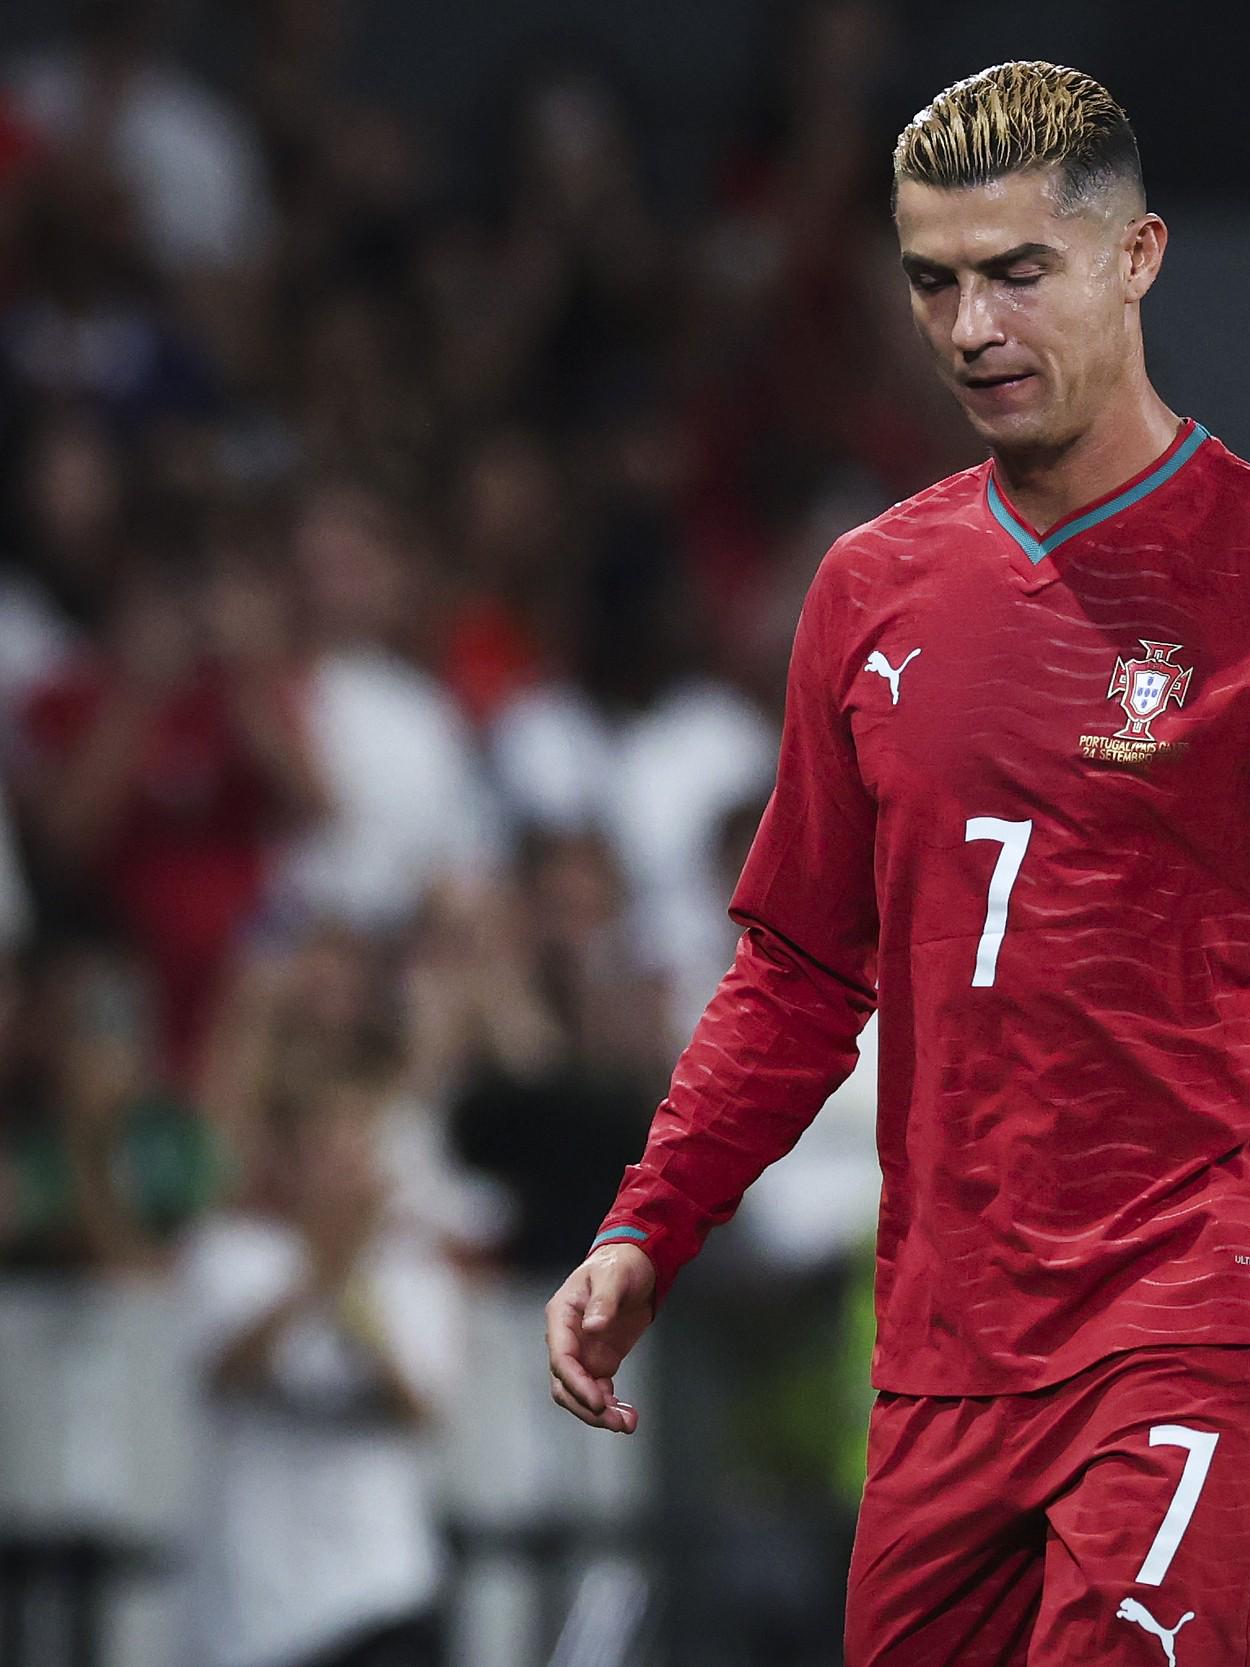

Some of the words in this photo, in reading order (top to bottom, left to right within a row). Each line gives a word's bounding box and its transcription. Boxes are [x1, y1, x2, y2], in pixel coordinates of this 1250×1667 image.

[1082, 747, 1096, 758] 24
[1099, 748, 1153, 762] SETEMBRO
[964, 816, 1032, 987] 7
[1135, 1425, 1220, 1586] 7
